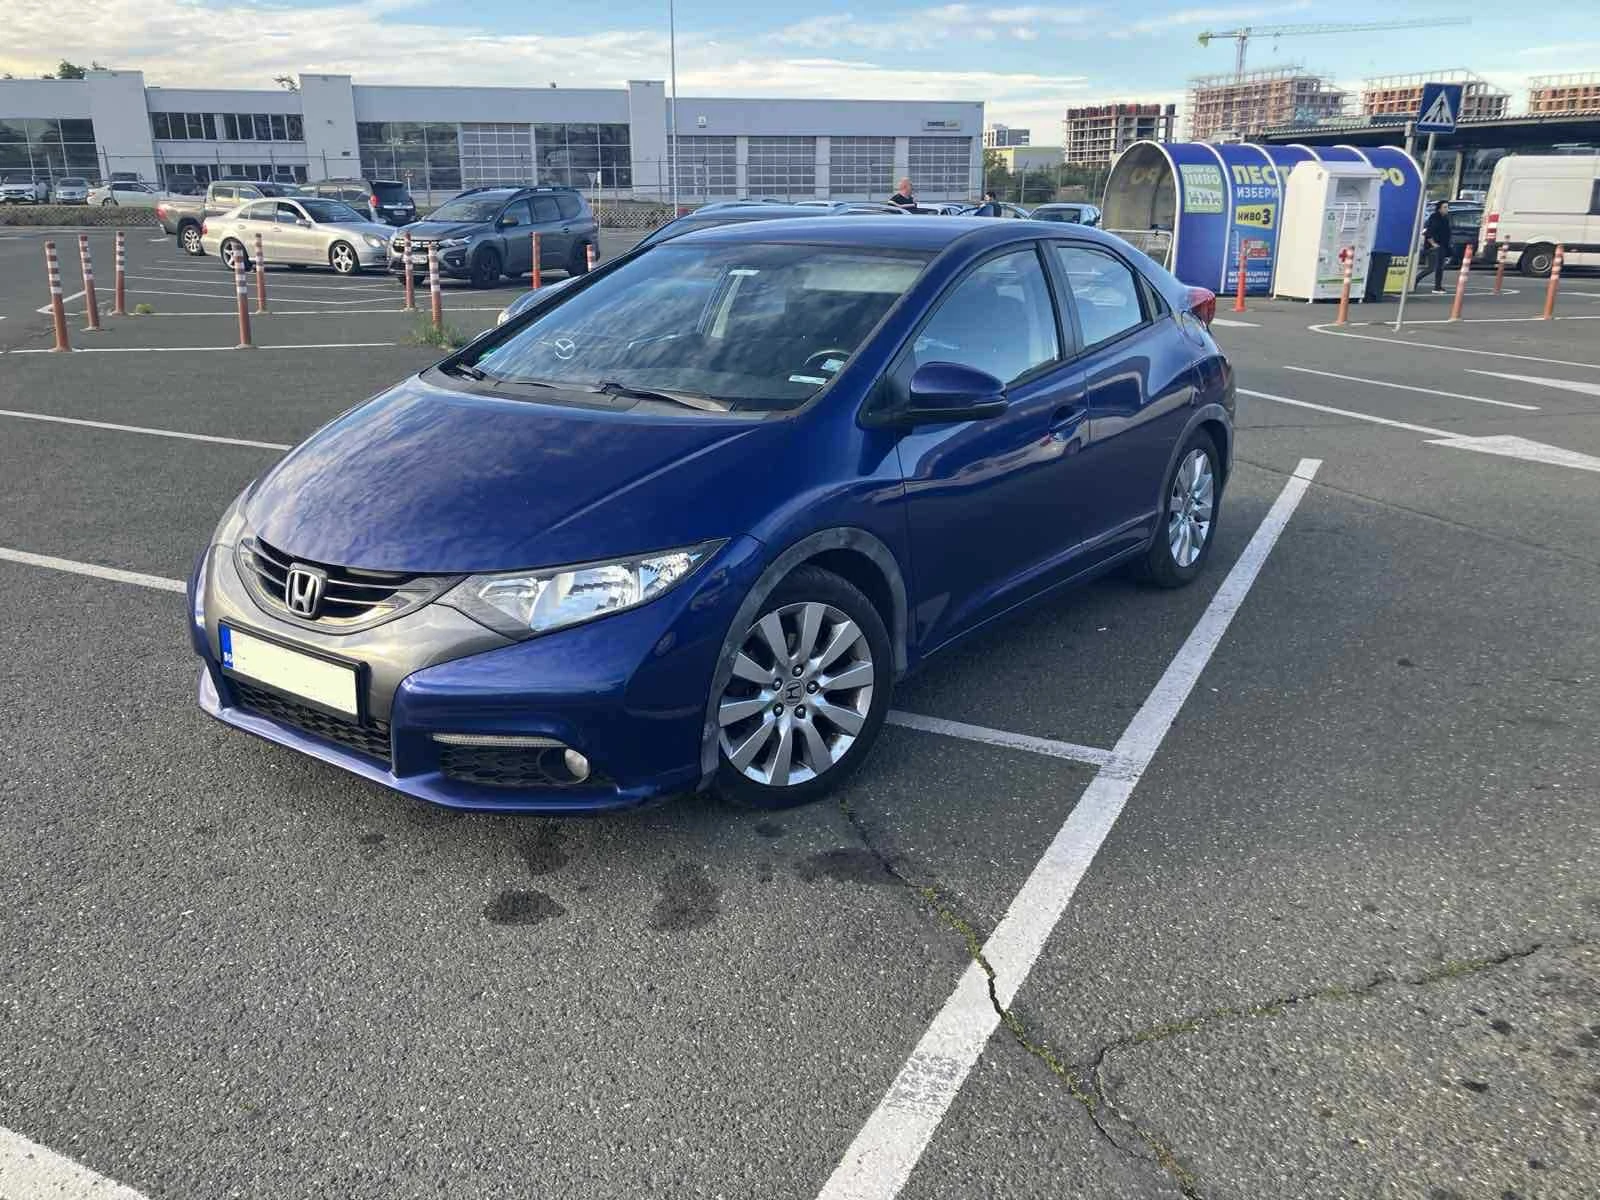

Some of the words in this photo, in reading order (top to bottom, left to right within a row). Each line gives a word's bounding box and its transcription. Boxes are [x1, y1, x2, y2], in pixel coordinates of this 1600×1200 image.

[1232, 165, 1292, 186] ПЕСТ
[1238, 211, 1261, 221] НИВО
[1262, 208, 1271, 225] 3
